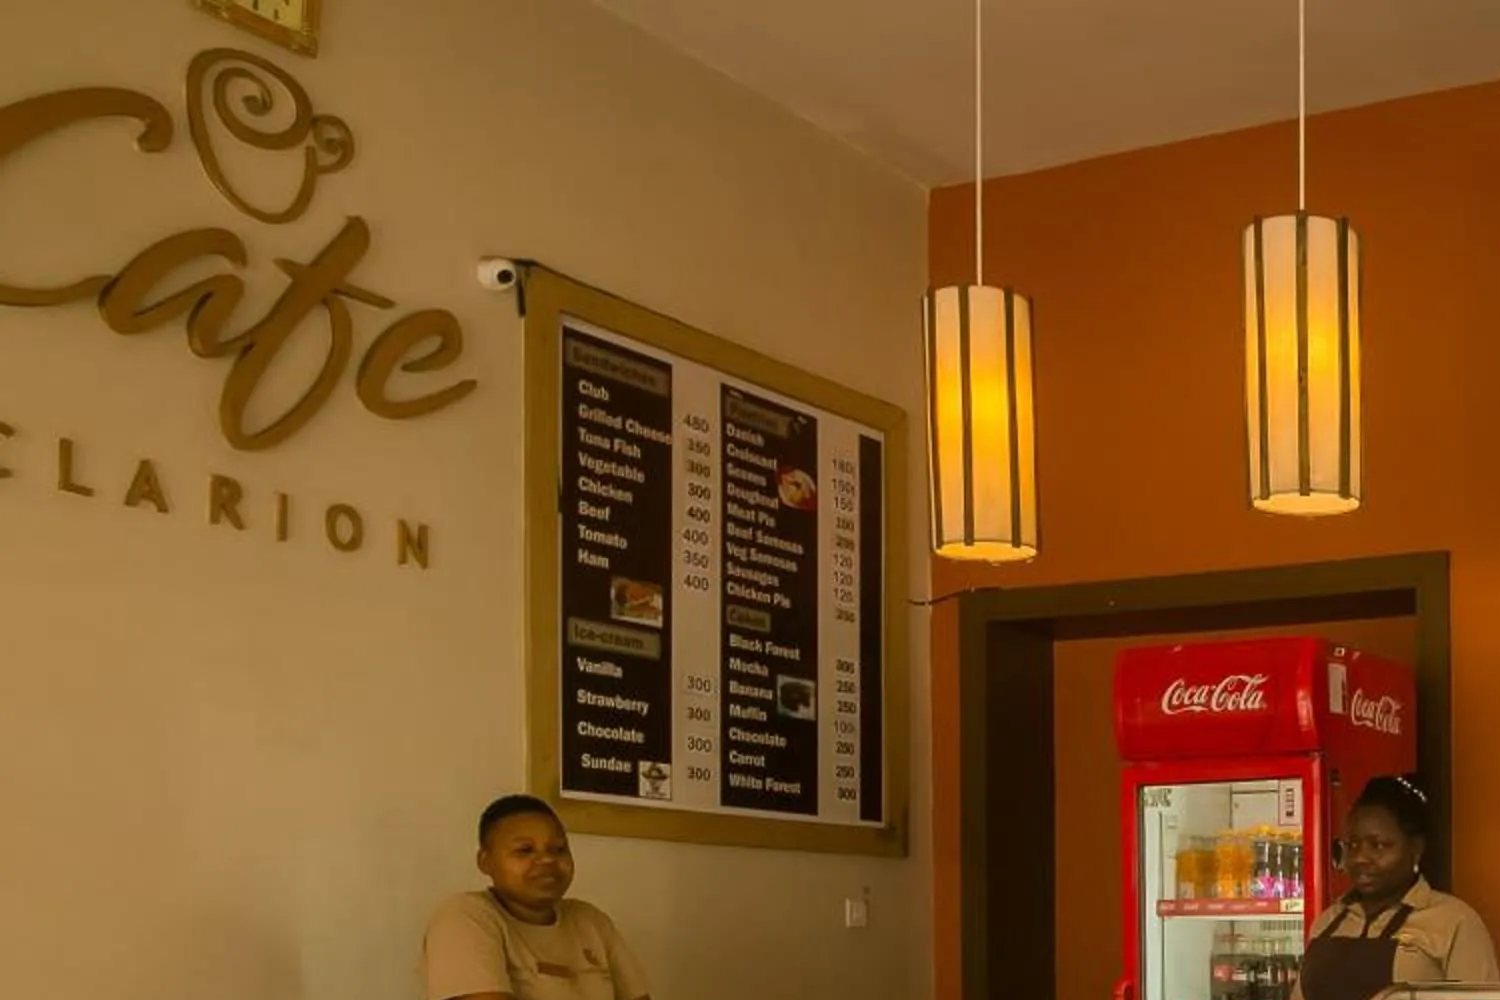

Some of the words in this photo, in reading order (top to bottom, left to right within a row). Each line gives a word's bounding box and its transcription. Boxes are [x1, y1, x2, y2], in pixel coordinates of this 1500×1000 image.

[578, 380, 609, 401] Club
[578, 404, 622, 430] Grilled
[625, 419, 673, 445] Cheese
[577, 428, 611, 449] Tuna
[613, 438, 641, 459] Fish
[578, 452, 645, 483] Vegetable
[578, 477, 633, 504] Chicken
[578, 501, 611, 521] Beef
[577, 524, 628, 550] Tomato
[578, 549, 610, 570] Ham
[683, 574, 709, 591] 400
[726, 581, 771, 604] Chicken
[729, 633, 762, 653] Black
[765, 641, 800, 661] Forest
[577, 657, 623, 679] Vanilla
[687, 676, 711, 692] 300
[577, 689, 649, 716] Strawberry
[1161, 674, 1268, 715] Coca-Cola
[1351, 688, 1402, 735] Coca-Cola
[577, 721, 645, 744] Chocolate
[687, 736, 712, 753] 300
[729, 727, 787, 748] Chocolate
[581, 753, 632, 773] Sundae
